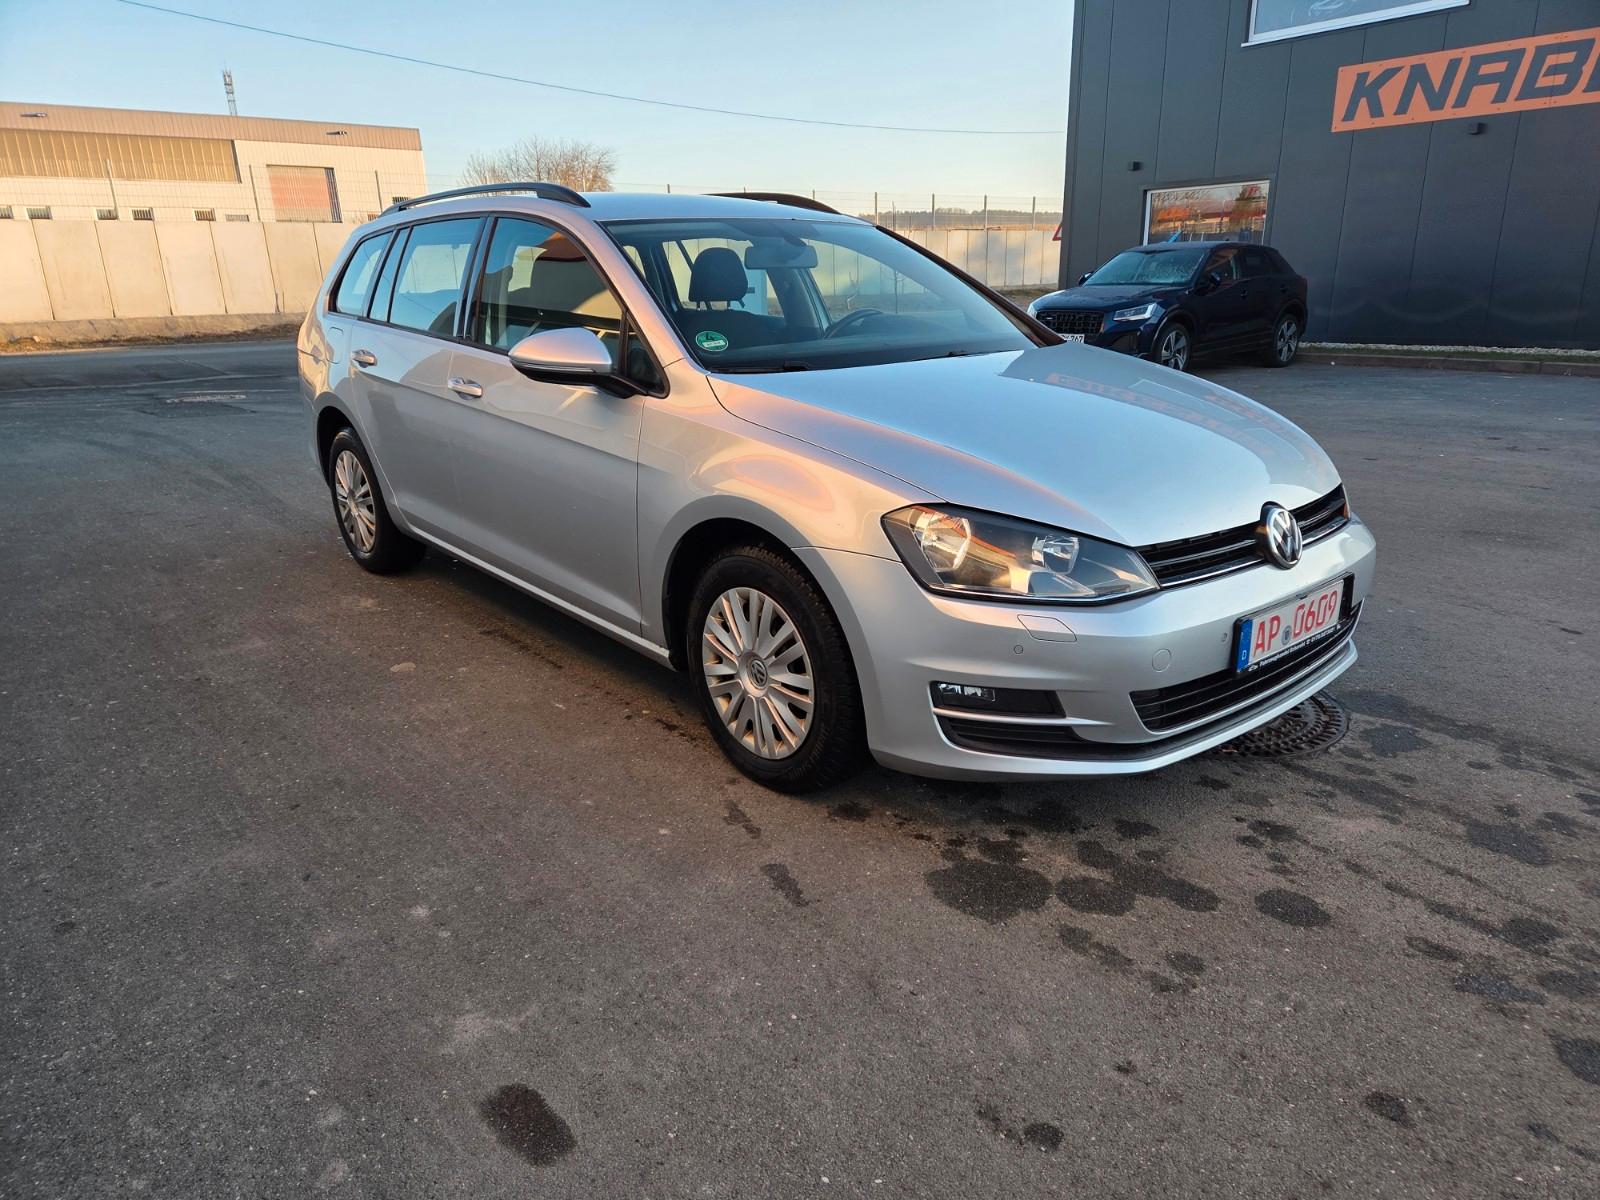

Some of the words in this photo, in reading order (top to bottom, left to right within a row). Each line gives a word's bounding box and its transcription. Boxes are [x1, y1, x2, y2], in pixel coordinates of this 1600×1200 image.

[1341, 38, 1600, 121] KNAB
[1253, 615, 1280, 656] AP
[1293, 590, 1337, 638] 0609
